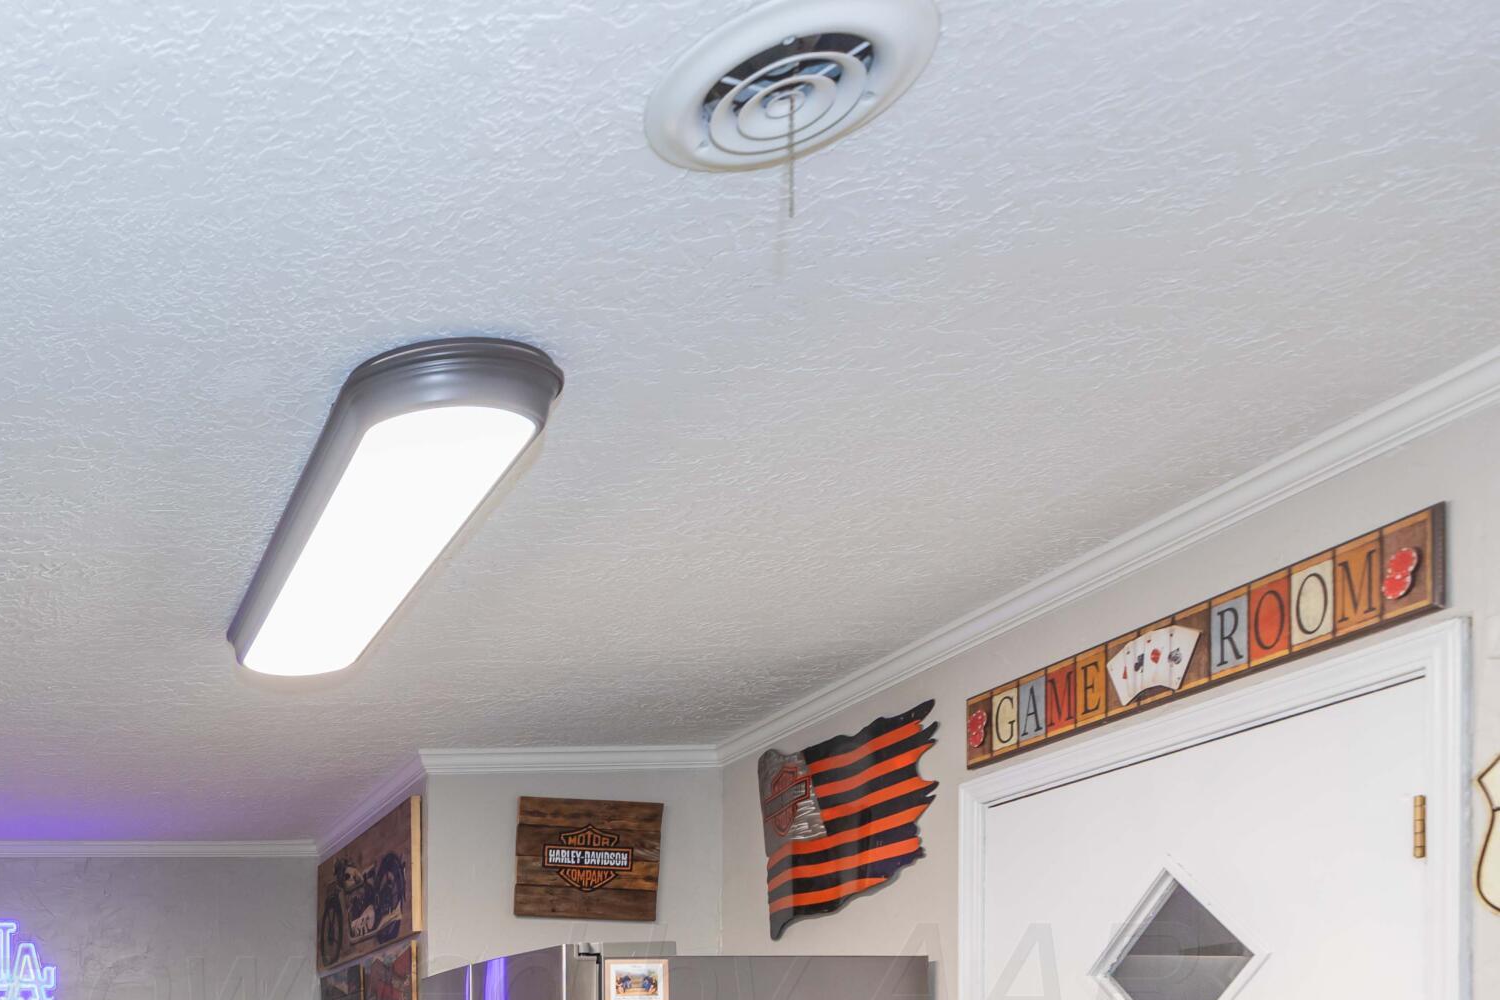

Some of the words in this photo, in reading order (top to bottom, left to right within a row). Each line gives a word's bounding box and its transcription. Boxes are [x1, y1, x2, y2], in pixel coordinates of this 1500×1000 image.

[995, 661, 1101, 744] GAME
[1217, 549, 1376, 667] ROOM
[568, 831, 610, 847] MOTOR
[548, 849, 628, 867] HARLEY-DAVIDSON
[566, 868, 608, 888] COMPANY
